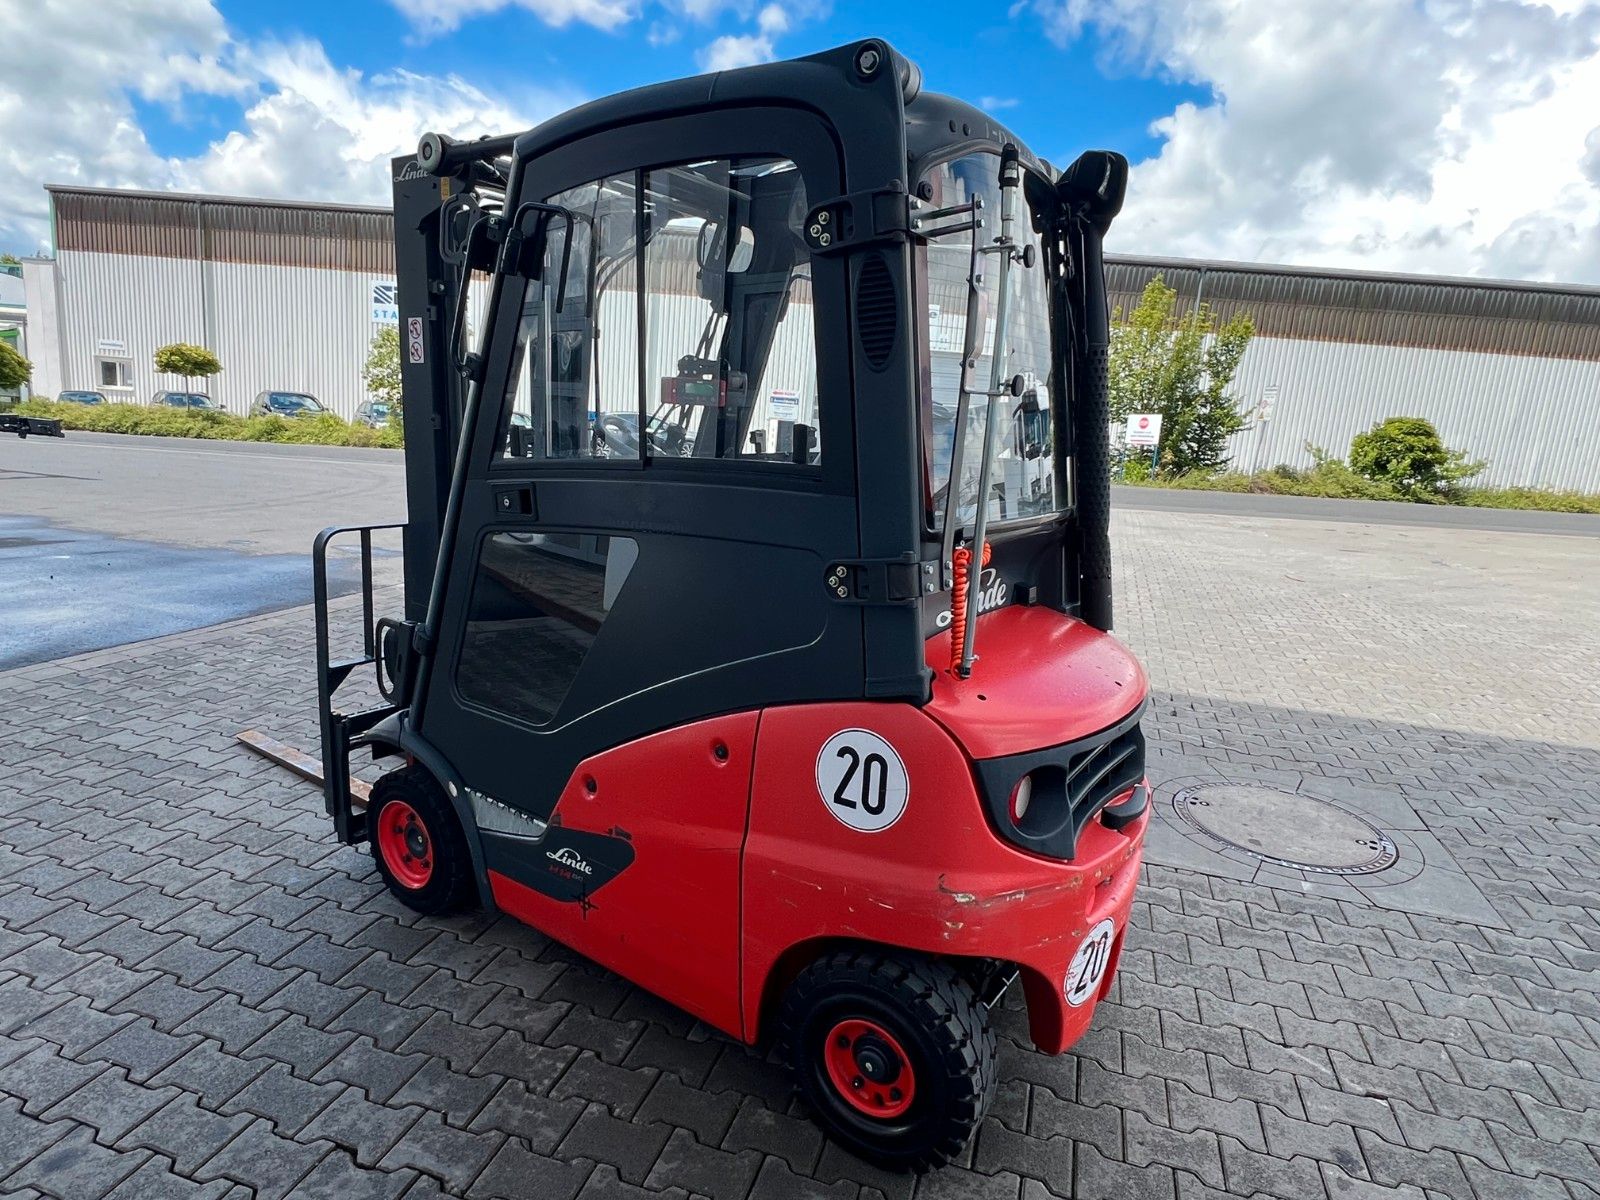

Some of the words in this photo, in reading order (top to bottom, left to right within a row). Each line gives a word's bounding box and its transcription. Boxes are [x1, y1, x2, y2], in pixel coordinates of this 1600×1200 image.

[833, 745, 889, 816] 20
[546, 847, 592, 875] Linde
[1074, 930, 1109, 996] 20
